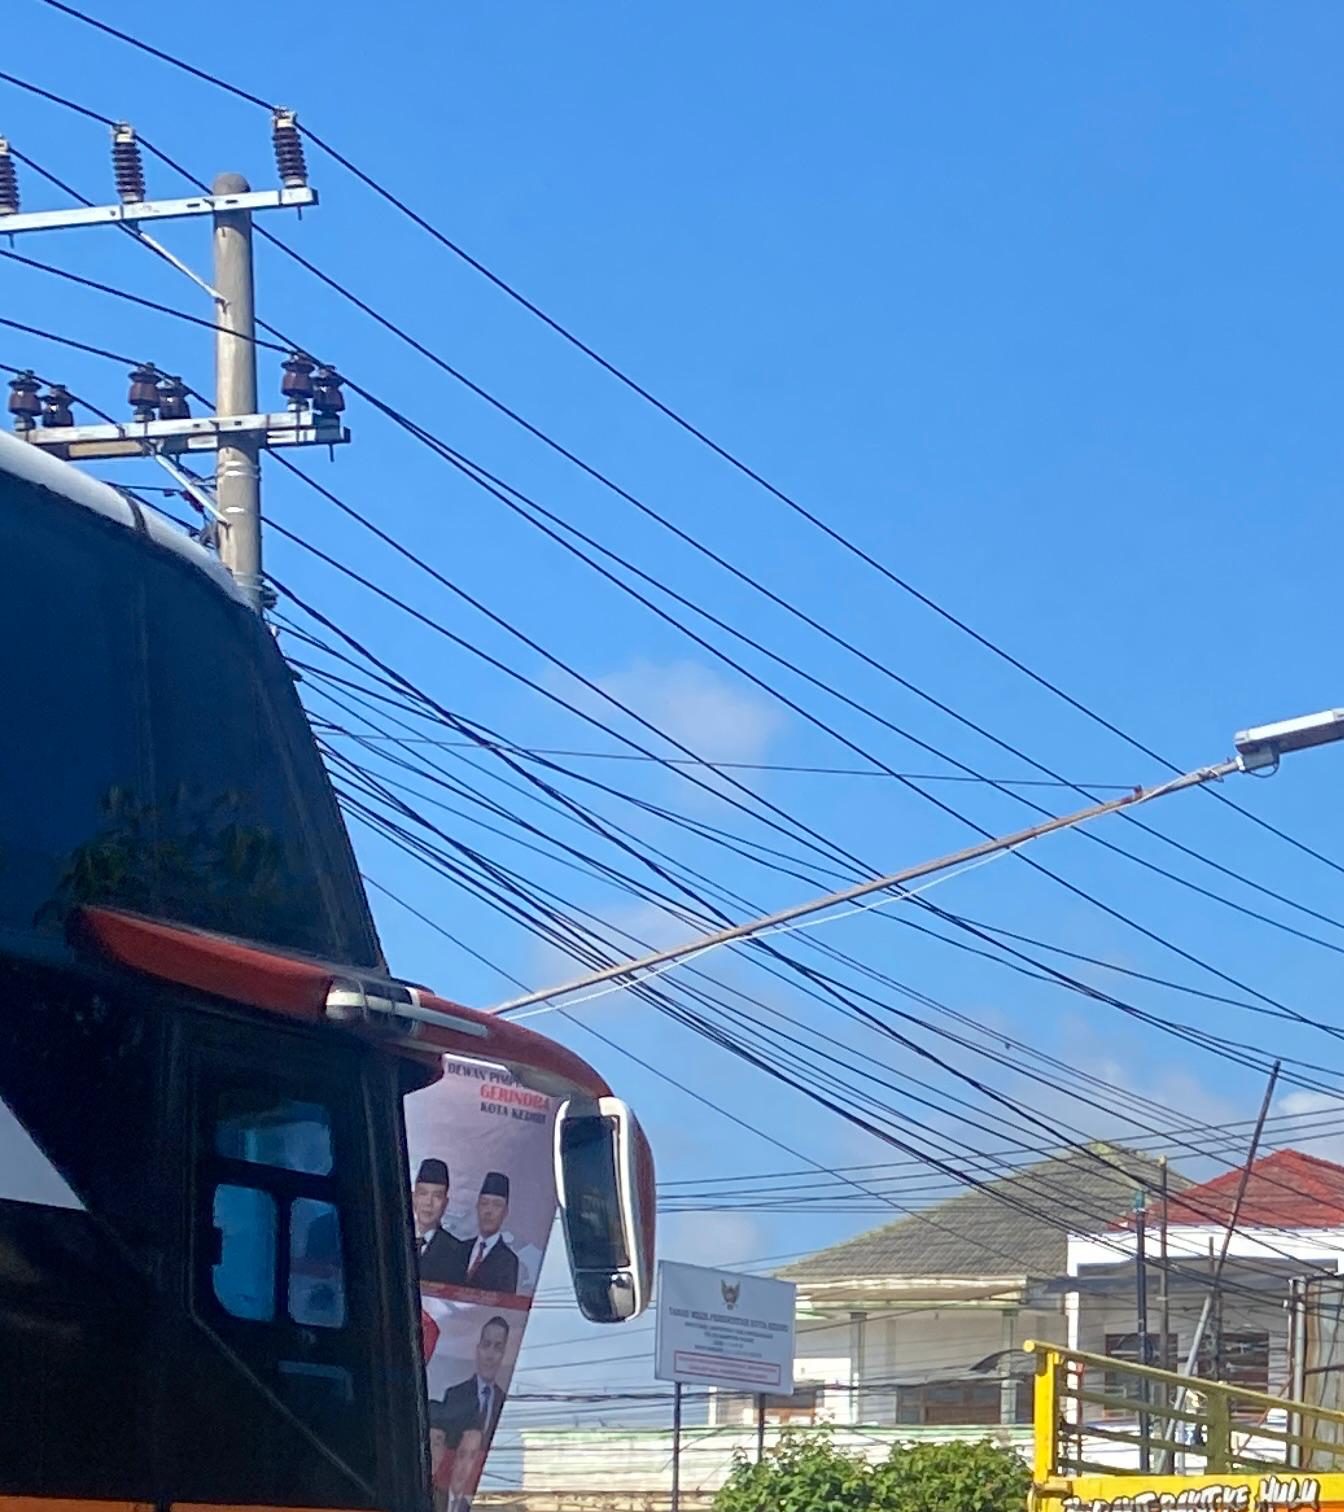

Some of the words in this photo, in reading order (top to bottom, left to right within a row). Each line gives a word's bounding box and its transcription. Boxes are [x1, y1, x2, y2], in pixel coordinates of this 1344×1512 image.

[448, 1062, 486, 1080] DEWAN
[480, 1083, 550, 1111] GERINDRA
[480, 1101, 508, 1116] KOTA
